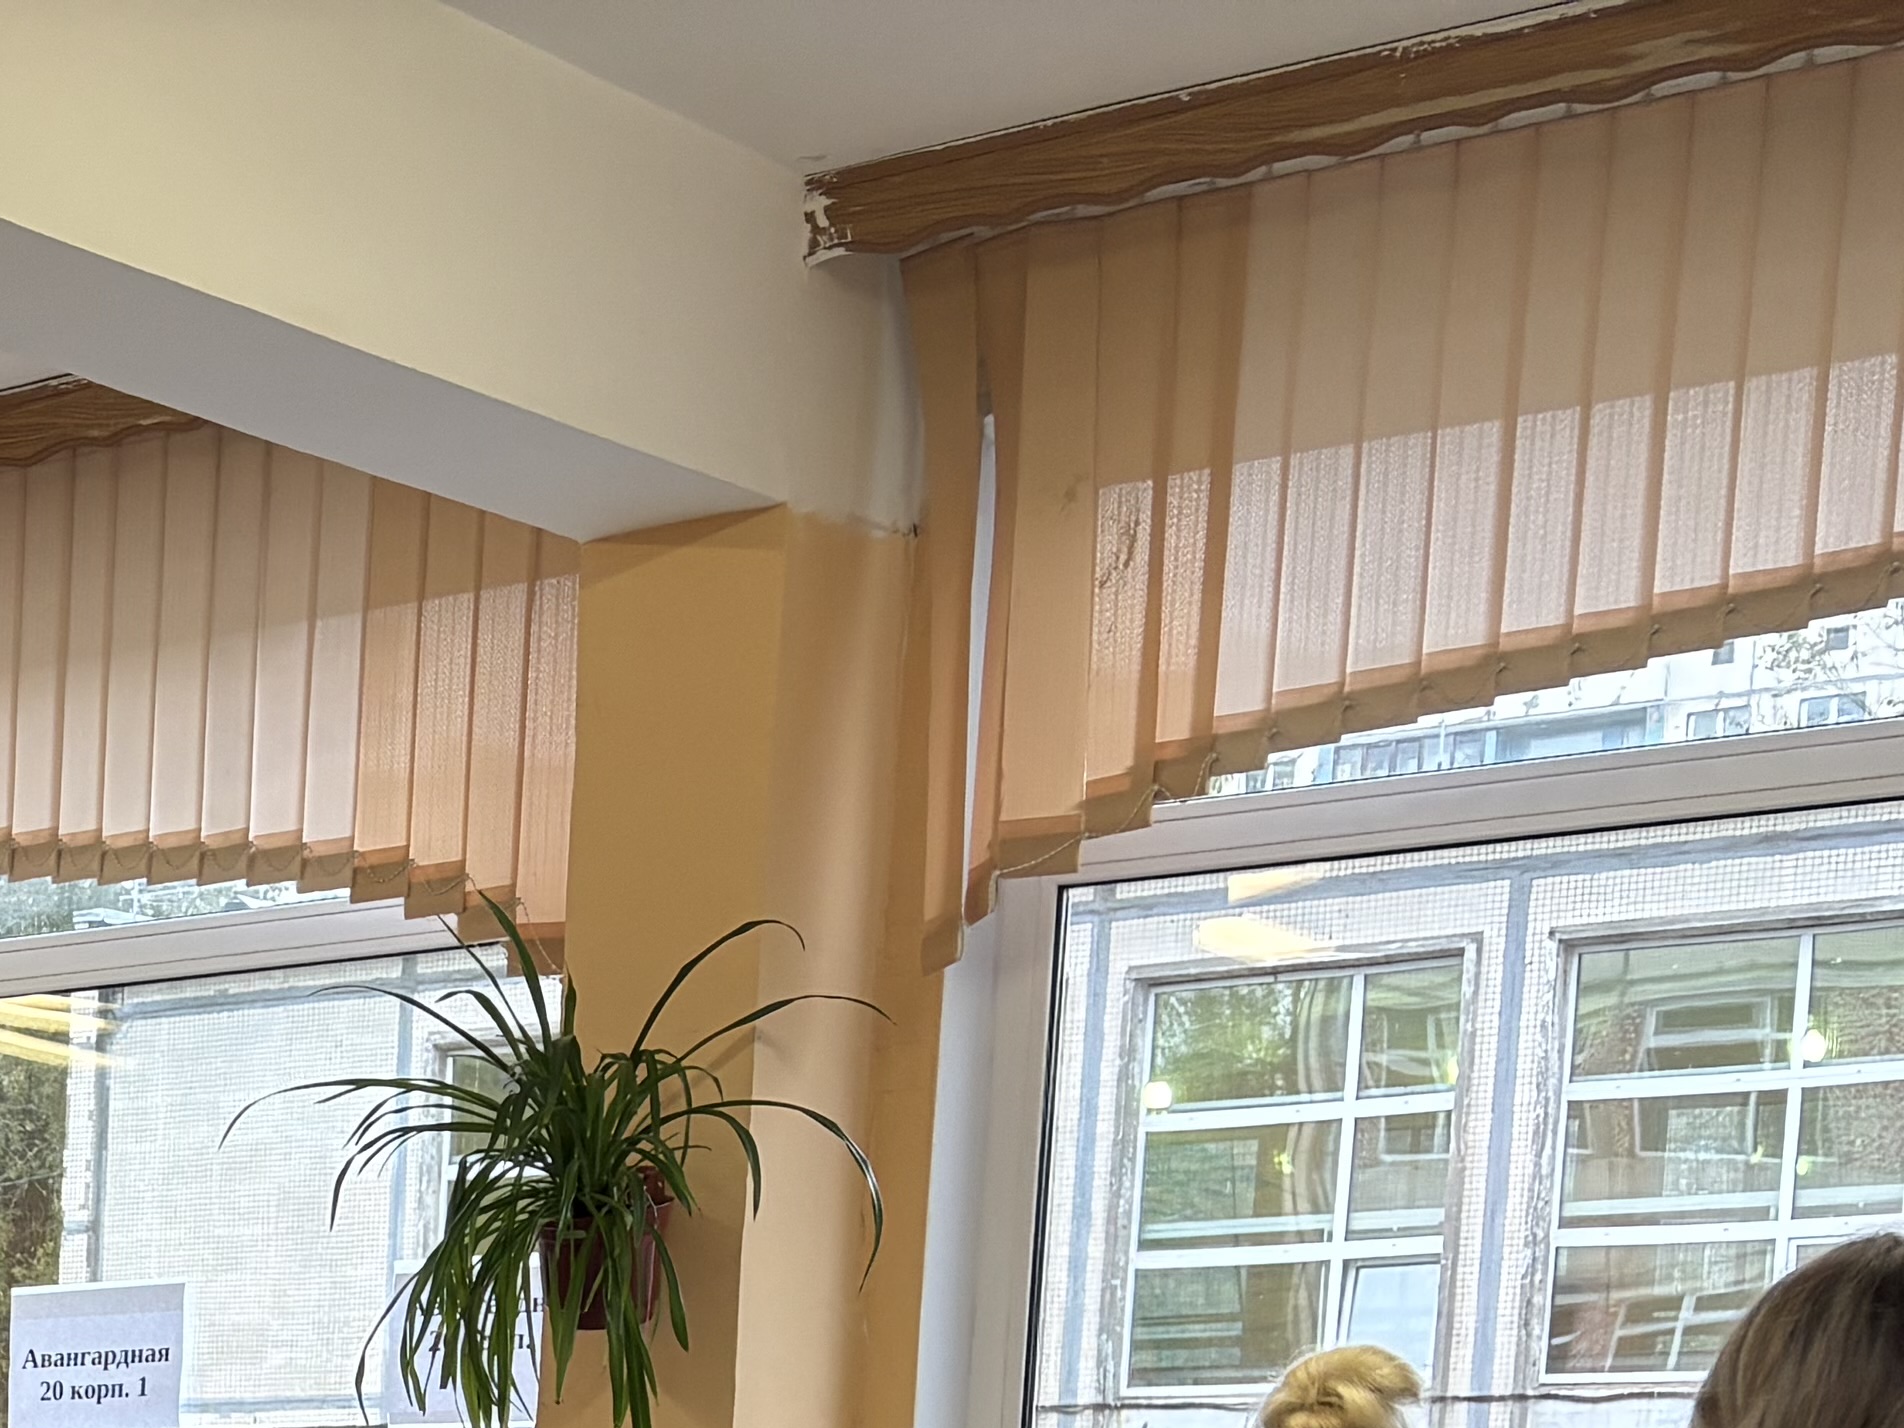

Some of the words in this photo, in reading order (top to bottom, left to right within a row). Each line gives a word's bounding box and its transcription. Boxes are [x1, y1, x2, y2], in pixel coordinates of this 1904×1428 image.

[22, 1347, 170, 1371] Авангардная
[40, 1380, 64, 1401] 20
[70, 1382, 130, 1405] корп.
[137, 1376, 148, 1397] 1
